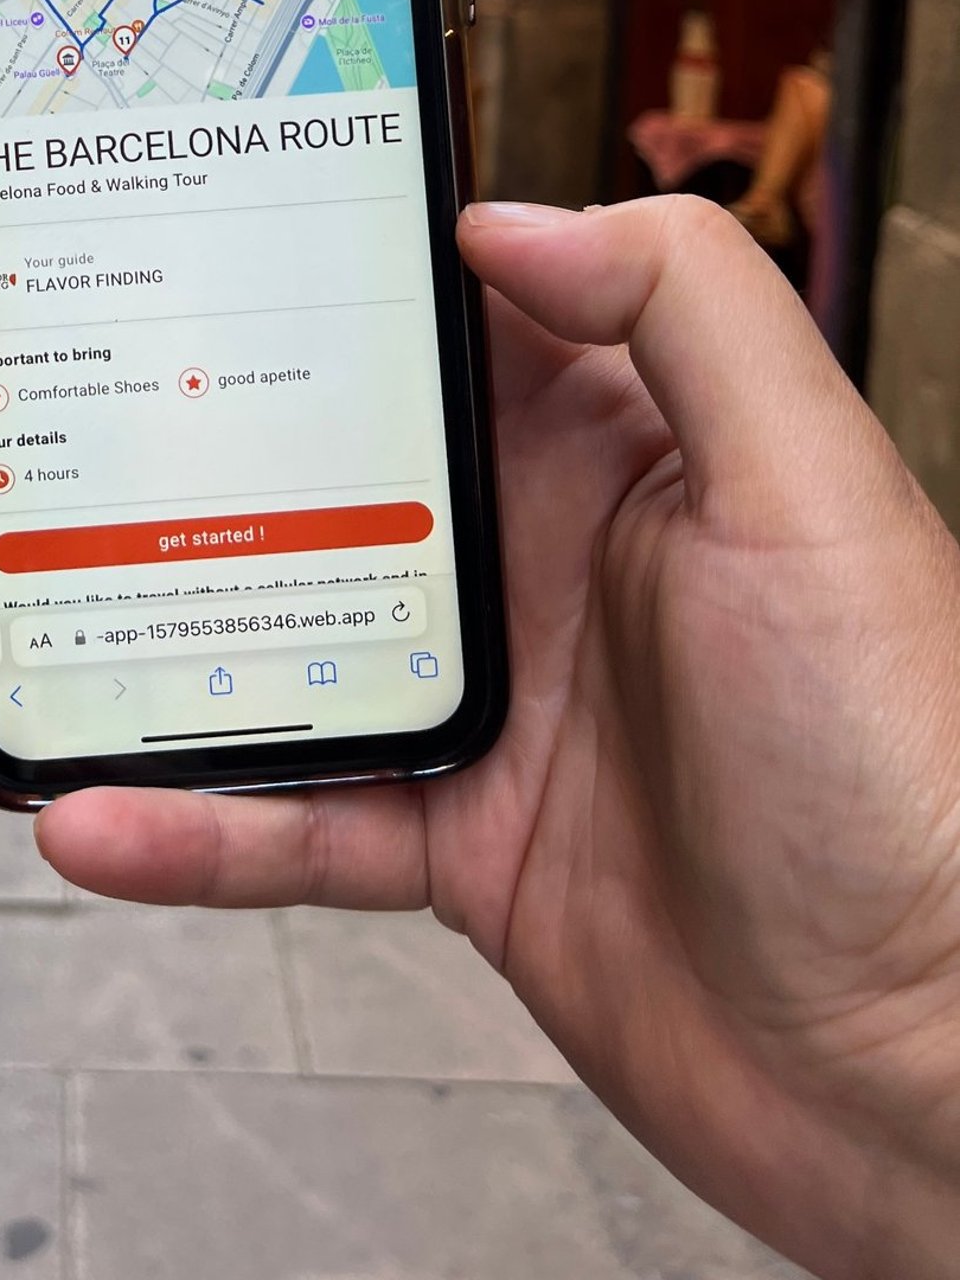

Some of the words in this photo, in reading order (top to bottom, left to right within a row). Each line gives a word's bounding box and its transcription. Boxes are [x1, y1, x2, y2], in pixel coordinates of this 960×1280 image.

[5, 17, 28, 26] Liceu
[318, 17, 337, 26] Moll
[338, 16, 350, 25] de
[224, 20, 238, 44] Carrer
[17, 34, 28, 50] Pau
[119, 36, 130, 45] 11
[92, 60, 116, 70] Plaça
[98, 68, 125, 78] Teatre
[243, 53, 260, 77] Colom
[14, 71, 38, 80] Palau
[45, 123, 271, 169] BARCELONA
[279, 113, 403, 152] ROUTE
[47, 180, 86, 197] Food
[90, 180, 102, 193] &
[106, 174, 169, 192] Walking
[173, 172, 208, 187] Tour
[24, 257, 54, 269] Your
[57, 253, 95, 269] guide
[26, 275, 91, 293] FLAVOR
[96, 269, 164, 288] FINDING
[53, 350, 68, 362] to
[72, 347, 112, 362] bring
[218, 370, 256, 390] good
[260, 368, 311, 386] apetite
[18, 382, 110, 402] Comfortable
[114, 380, 160, 394] Shoes
[16, 430, 67, 447] details
[24, 469, 33, 482] 4
[38, 468, 79, 482] hours
[159, 532, 187, 552] get
[192, 525, 254, 546] started
[96, 609, 376, 645] -app-1579553856346.web.app
